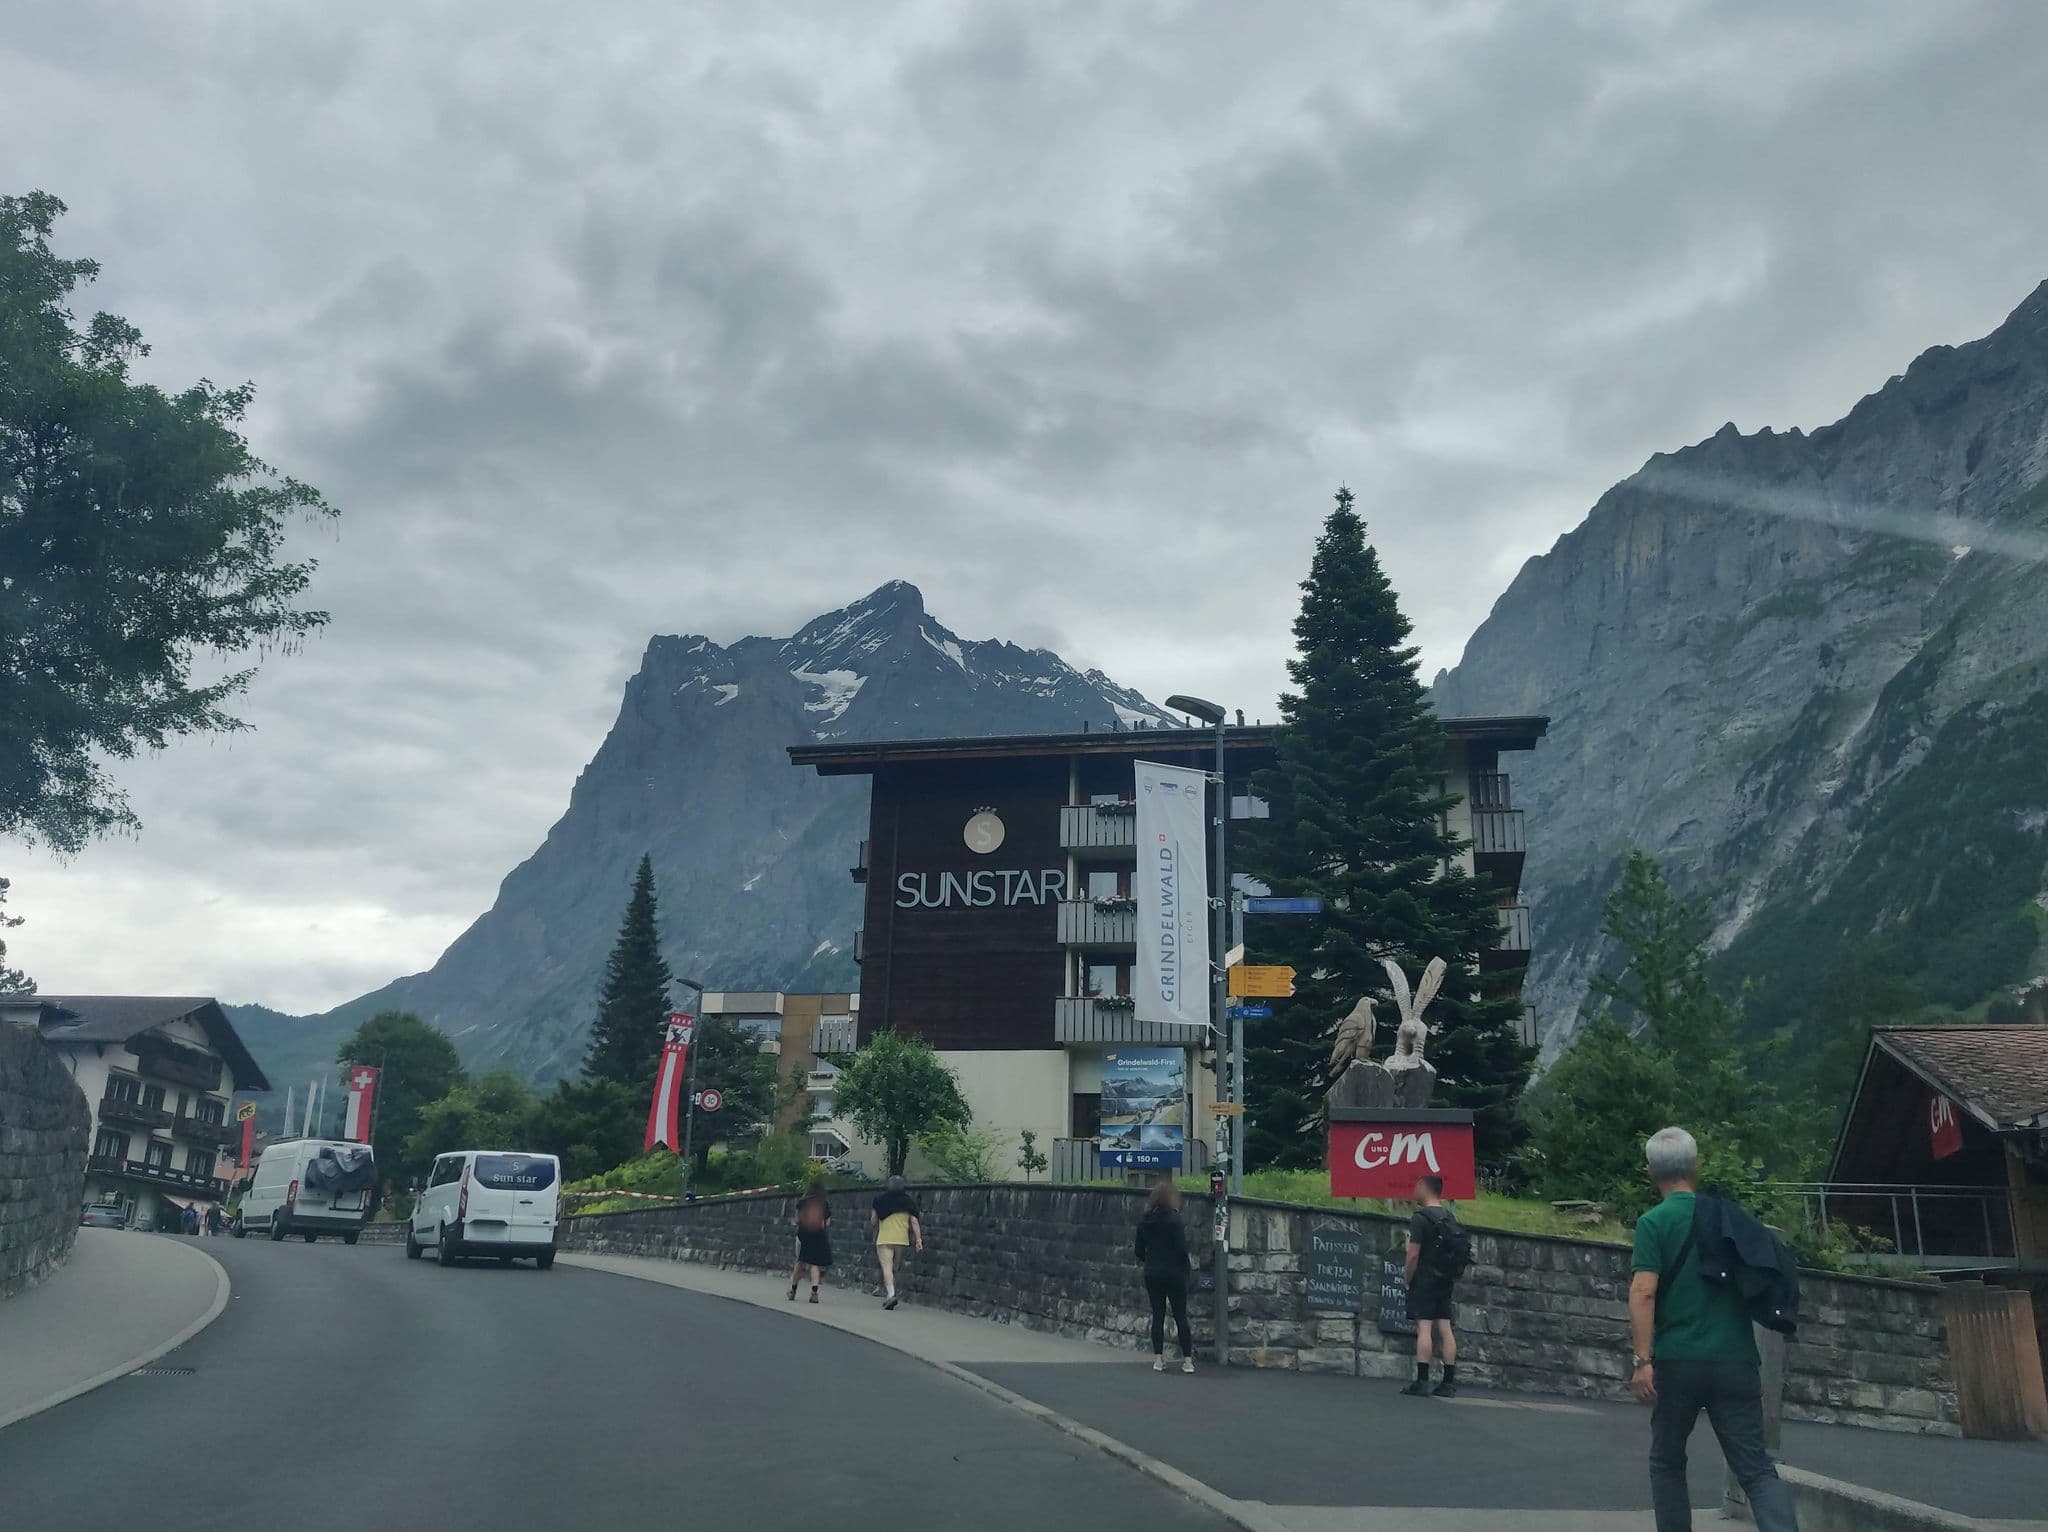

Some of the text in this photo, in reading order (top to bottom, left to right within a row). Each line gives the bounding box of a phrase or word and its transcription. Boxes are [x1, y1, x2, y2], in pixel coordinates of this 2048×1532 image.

[896, 869, 1066, 908] SUNSTAR
[1160, 847, 1175, 1002] GRINDELWALD
[1117, 1058, 1176, 1067] Grindelwald-First
[706, 1096, 715, 1105] 30
[1136, 1155, 1150, 1163] 150
[493, 1173, 538, 1183] Sun star
